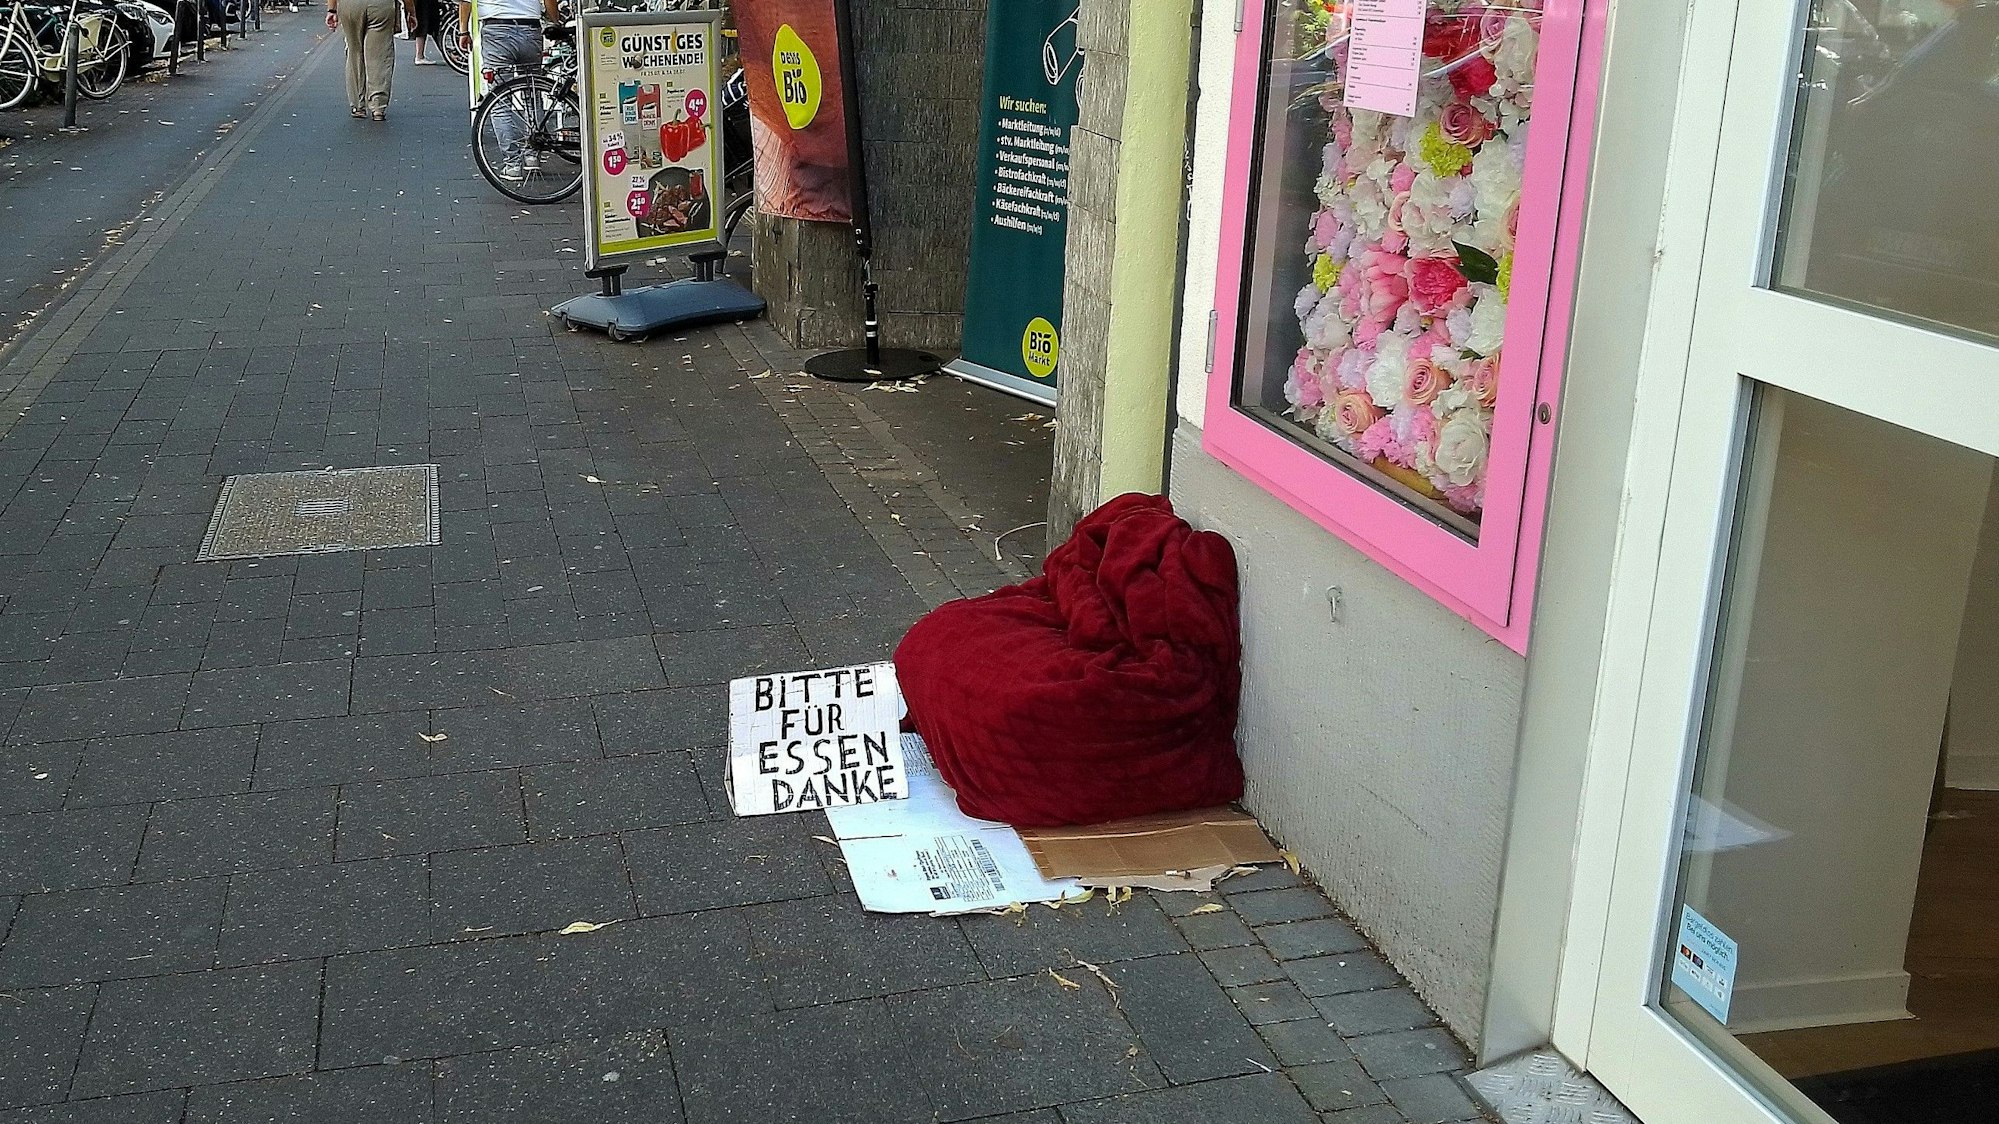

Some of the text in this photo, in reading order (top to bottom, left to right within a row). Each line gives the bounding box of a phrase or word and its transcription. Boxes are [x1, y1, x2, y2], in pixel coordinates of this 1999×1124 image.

[999, 95, 1047, 114] Wir suchen:
[1001, 117, 1044, 137] Marktleitung
[1000, 135, 1013, 146] stv.
[1013, 135, 1055, 155] Marktleitung
[999, 149, 1055, 169] Verkaufspersonal
[998, 166, 1047, 185] Bistrofachkraft
[996, 182, 1055, 203] Bäckereifachkraft
[995, 198, 1041, 217] Käsefachkraft
[993, 213, 1027, 230] Aushilfen
[1028, 352, 1051, 366] Markt
[755, 668, 874, 712] BITTE
[781, 703, 845, 740] FÜR
[759, 731, 890, 775] ESSEN
[772, 765, 898, 812] DANKE
